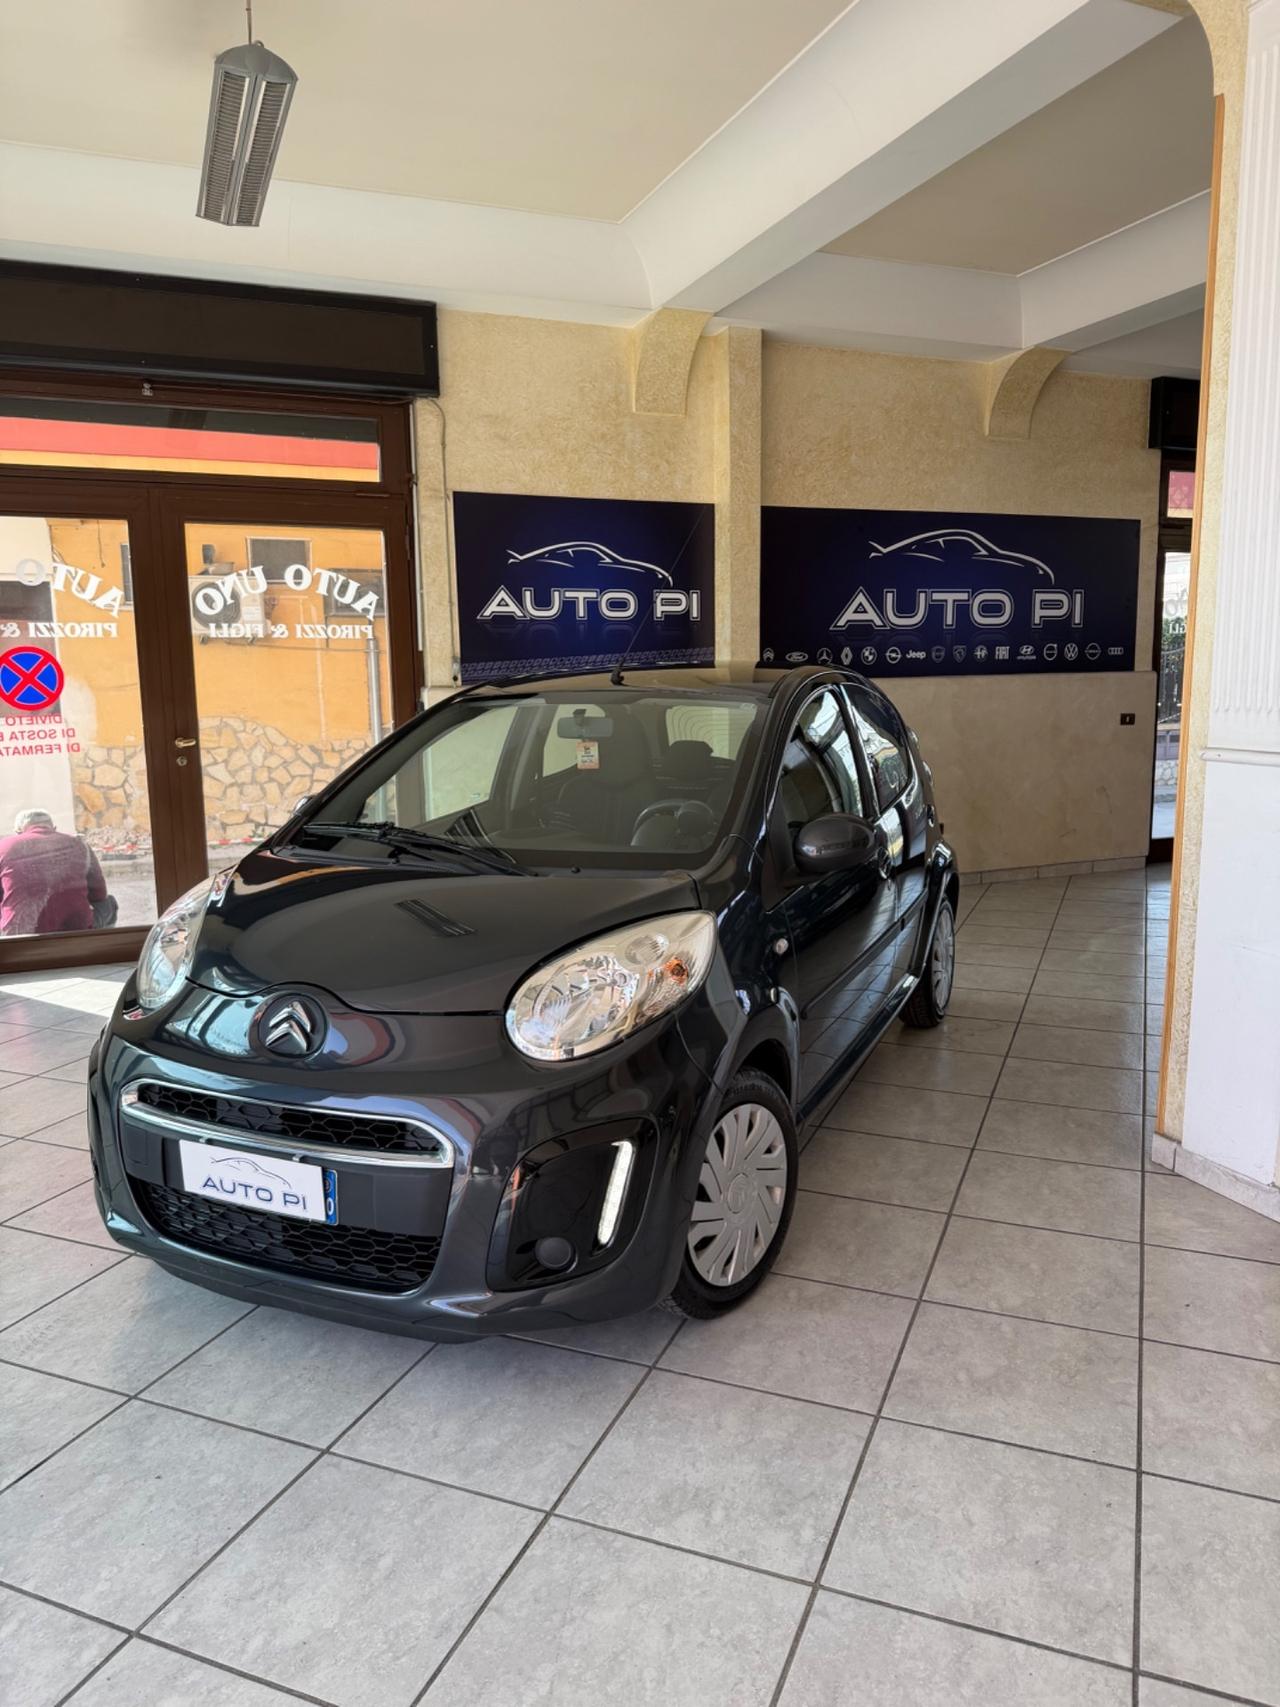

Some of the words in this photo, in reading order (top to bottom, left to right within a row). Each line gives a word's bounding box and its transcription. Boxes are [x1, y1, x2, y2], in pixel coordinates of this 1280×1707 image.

[477, 585, 638, 621] AUTO
[653, 588, 700, 621] PI
[829, 586, 1014, 630] AUTO
[1032, 588, 1084, 628] PI
[906, 649, 927, 660] Jeep
[203, 1177, 273, 1202] AUTO
[283, 1192, 307, 1210] PI
